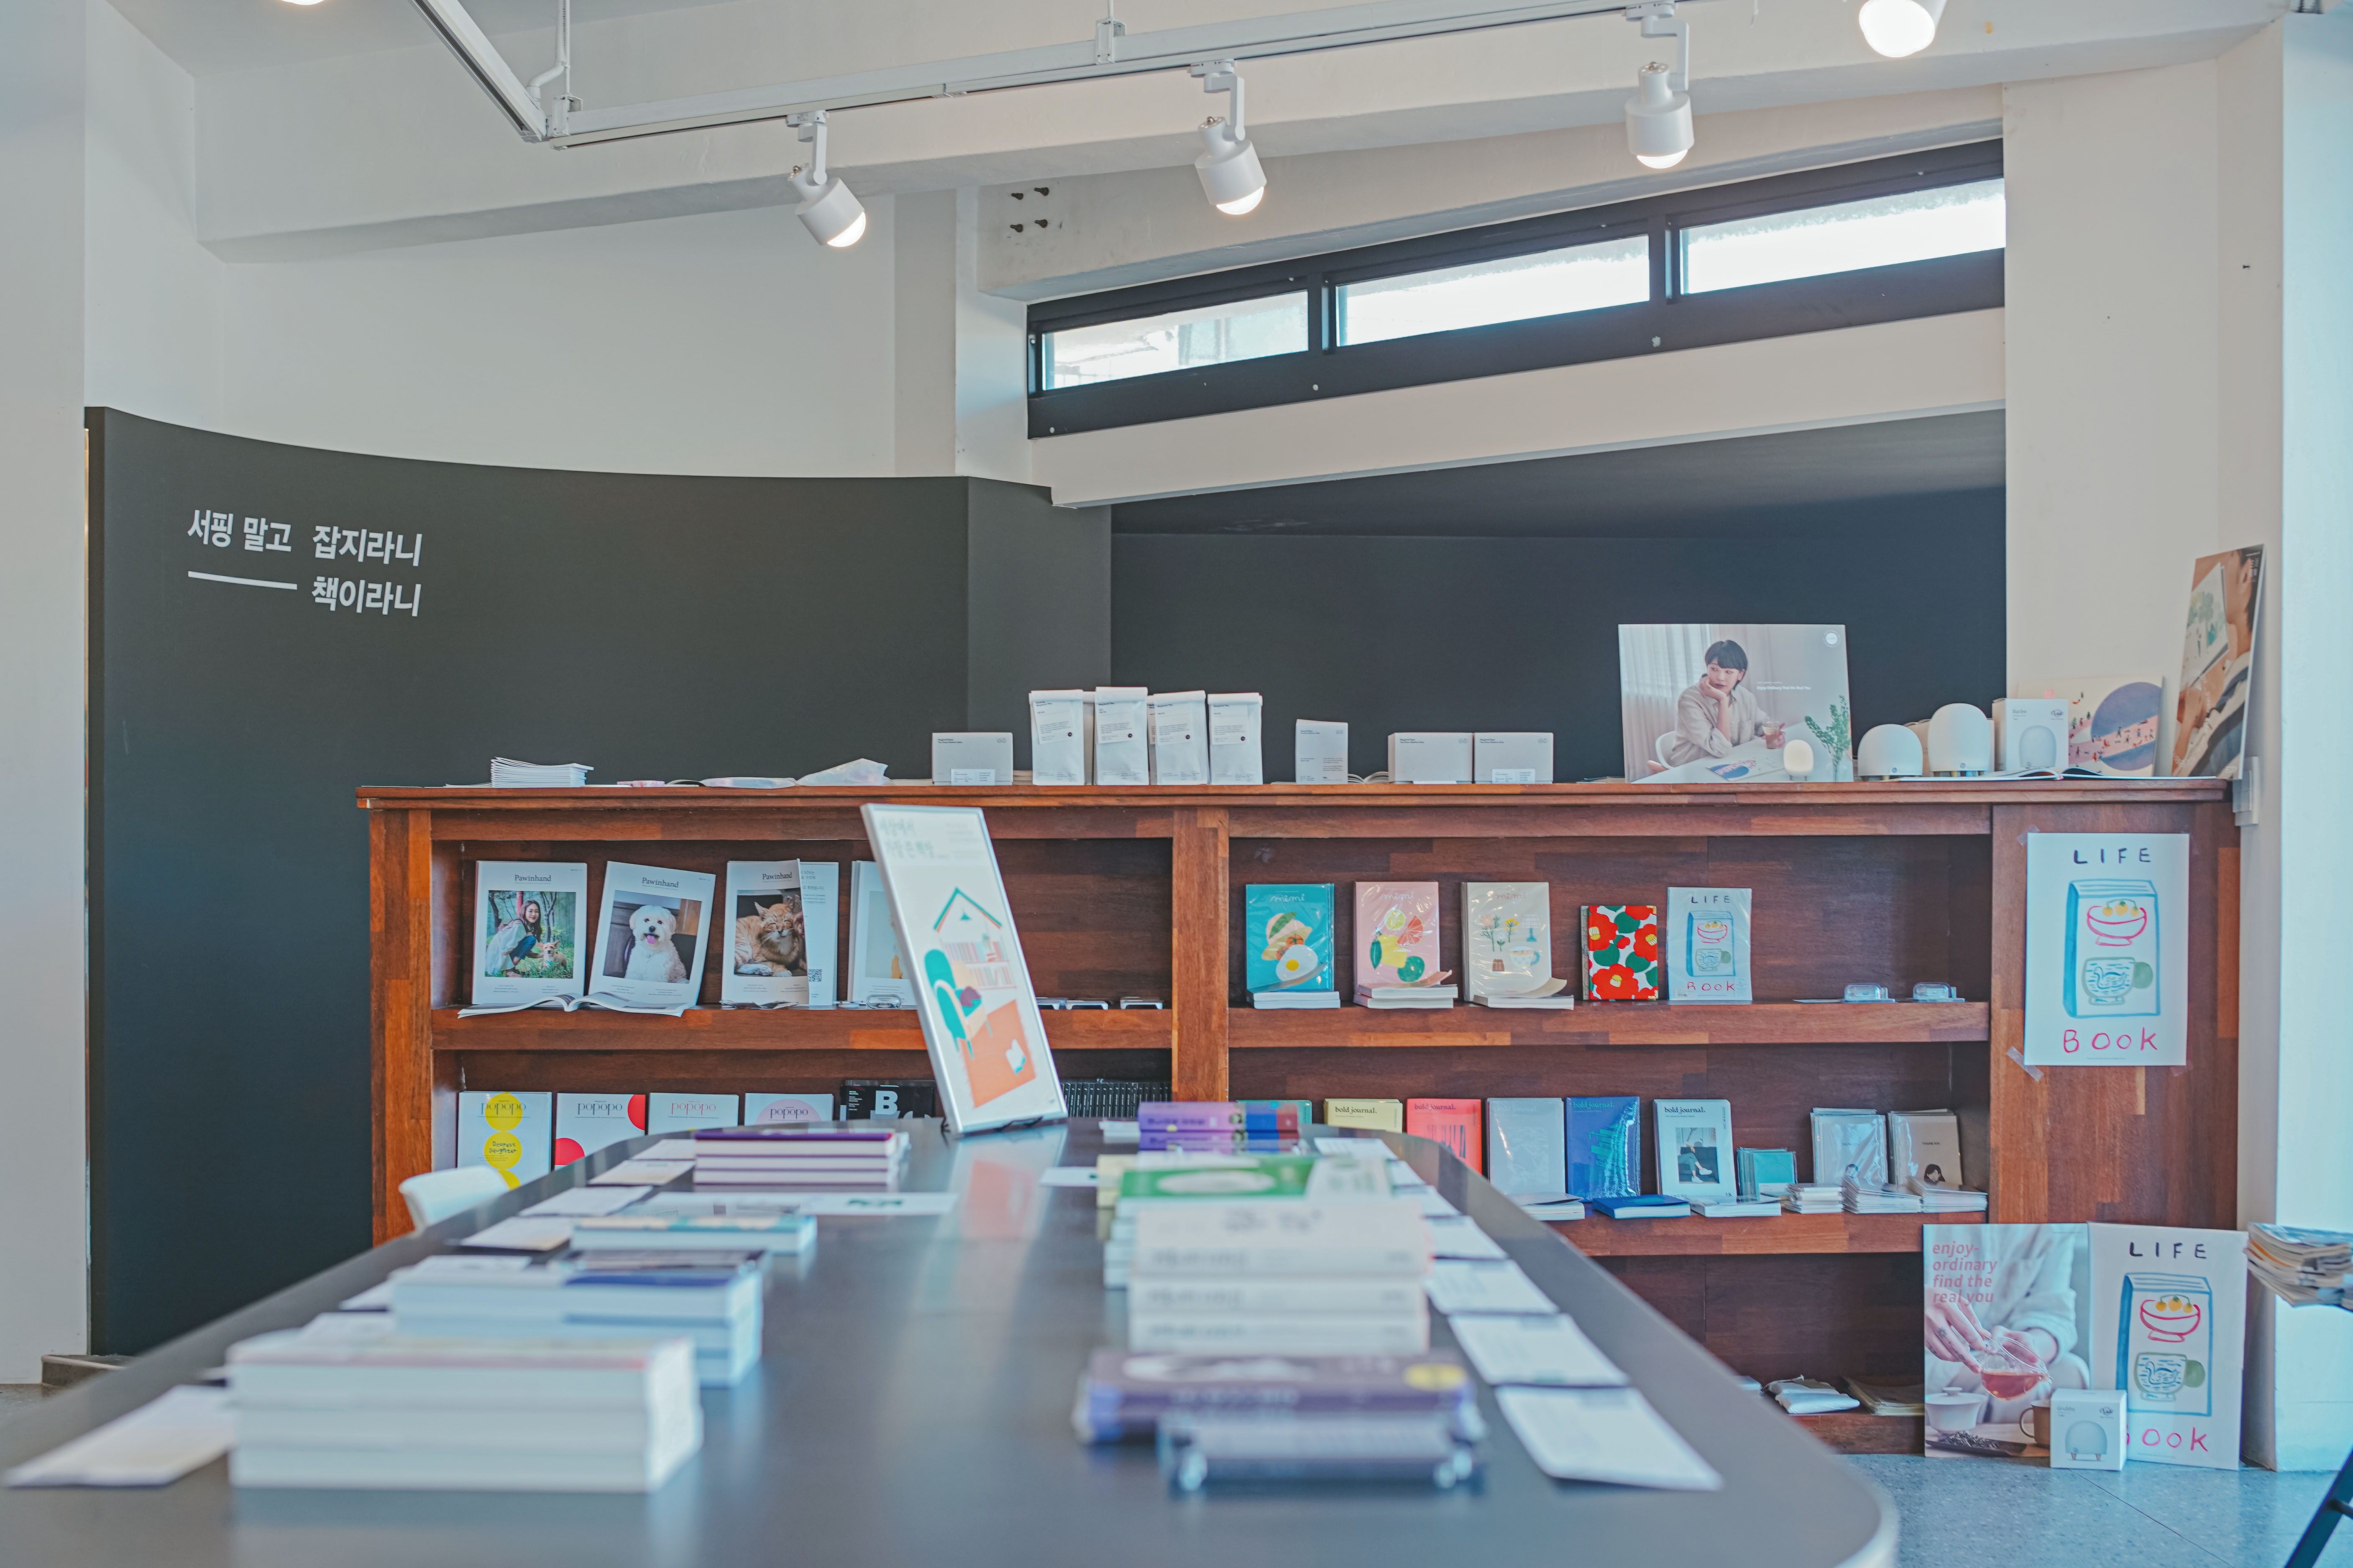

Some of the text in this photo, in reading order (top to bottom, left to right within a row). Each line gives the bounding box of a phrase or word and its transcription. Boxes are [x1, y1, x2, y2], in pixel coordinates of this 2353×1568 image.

[187, 509, 422, 567] 서핑 말고 잡지라니
[311, 576, 421, 617] 책이라니
[2073, 848, 2151, 864] LIFE
[642, 876, 679, 889] Pawinhand
[762, 872, 793, 880] Pawinhand
[1270, 893, 1305, 902] mimi
[1380, 892, 1414, 901] mimi
[1691, 895, 1731, 904] LIFE
[2063, 1027, 2158, 1053] BOOK
[481, 1103, 527, 1115] popopo
[578, 1102, 623, 1116] popopo
[671, 1102, 716, 1116] popopo
[875, 1090, 898, 1115] B
[1588, 1101, 1614, 1109] journal.
[770, 1107, 808, 1119] popopo
[1350, 1106, 1377, 1114] journal.
[1932, 1241, 1979, 1258] enjoy-
[2129, 1241, 2207, 1259] LIFE
[1933, 1258, 1997, 1274] ordinary
[1933, 1274, 1992, 1289] find the
[1933, 1290, 1994, 1305] real you
[2127, 1425, 2209, 1453] OOK
